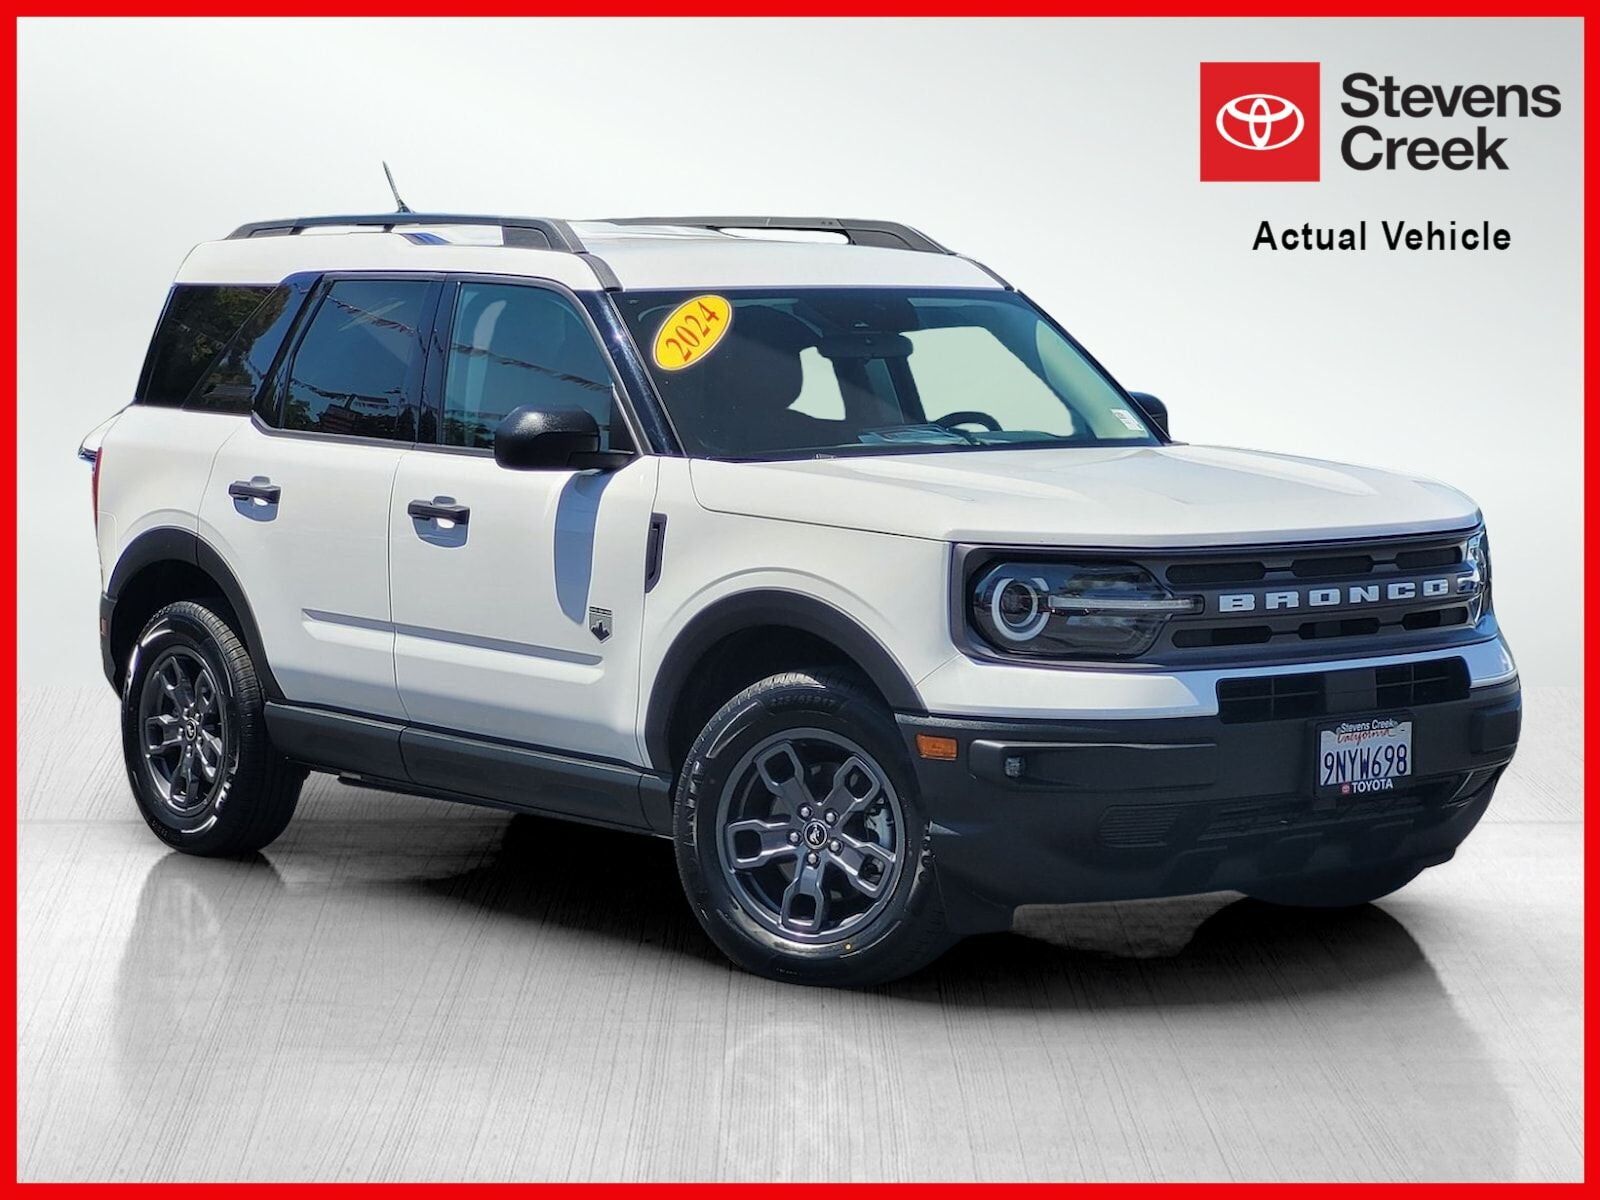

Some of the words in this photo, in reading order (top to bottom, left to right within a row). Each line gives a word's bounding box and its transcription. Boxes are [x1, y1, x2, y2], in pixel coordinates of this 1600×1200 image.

[665, 300, 720, 362] 2024
[1218, 578, 1449, 613] BRONCO
[1340, 722, 1371, 734] Stevens
[1371, 719, 1395, 730] Creek
[1324, 743, 1408, 786] 9NYW698
[1351, 778, 1394, 794] TOYOTA
